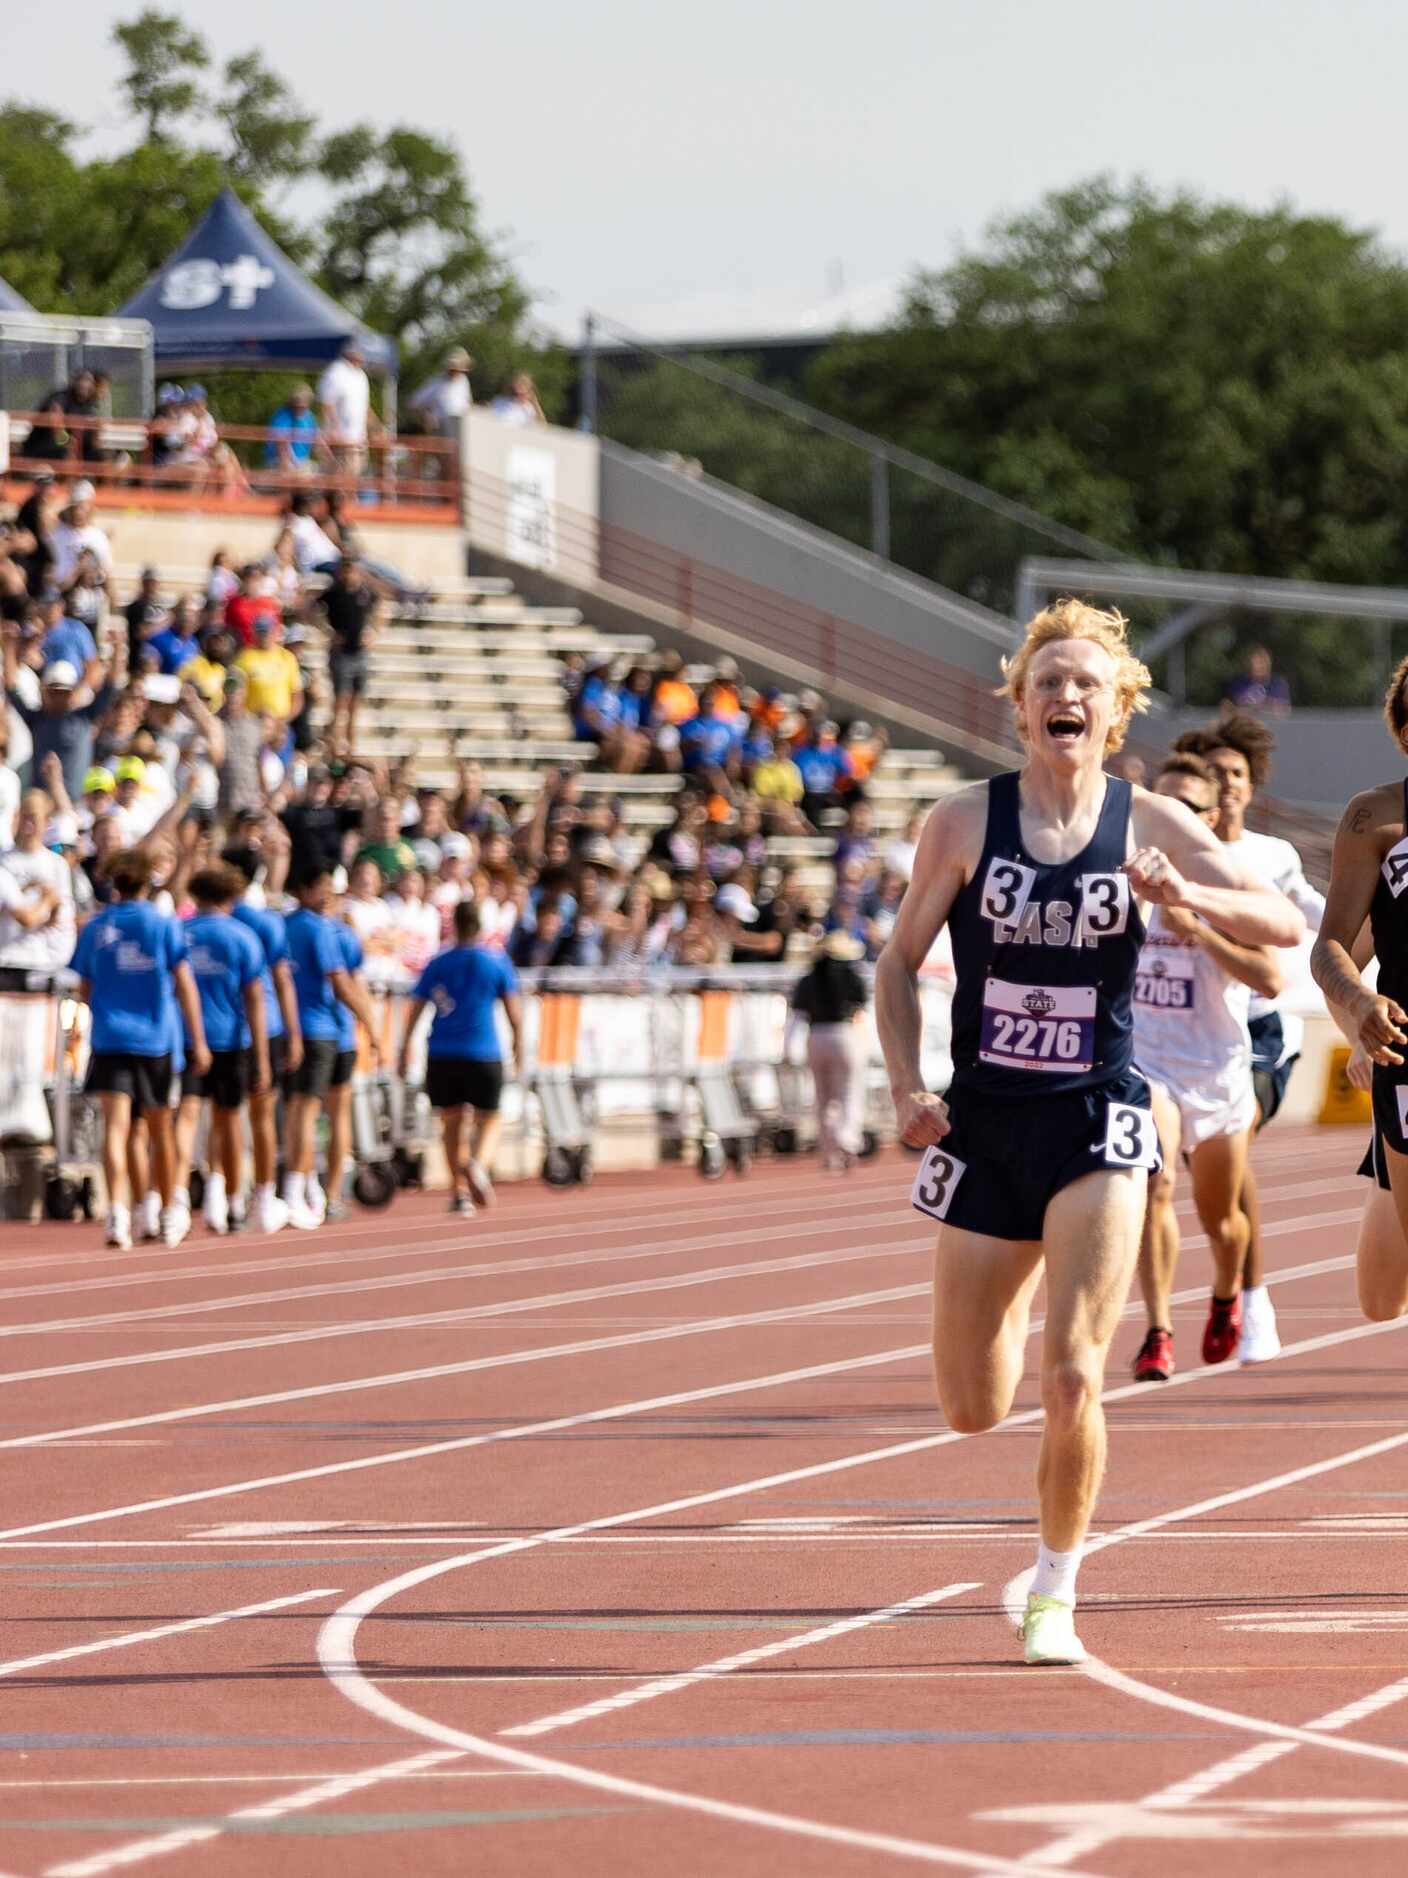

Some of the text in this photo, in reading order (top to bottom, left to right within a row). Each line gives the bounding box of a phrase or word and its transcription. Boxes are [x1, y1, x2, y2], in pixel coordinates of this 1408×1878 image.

[986, 865, 1023, 919] 3
[1088, 878, 1119, 931] 3
[992, 1014, 1081, 1058] 2276
[1113, 1109, 1142, 1160] 3
[919, 1154, 954, 1208] 3
